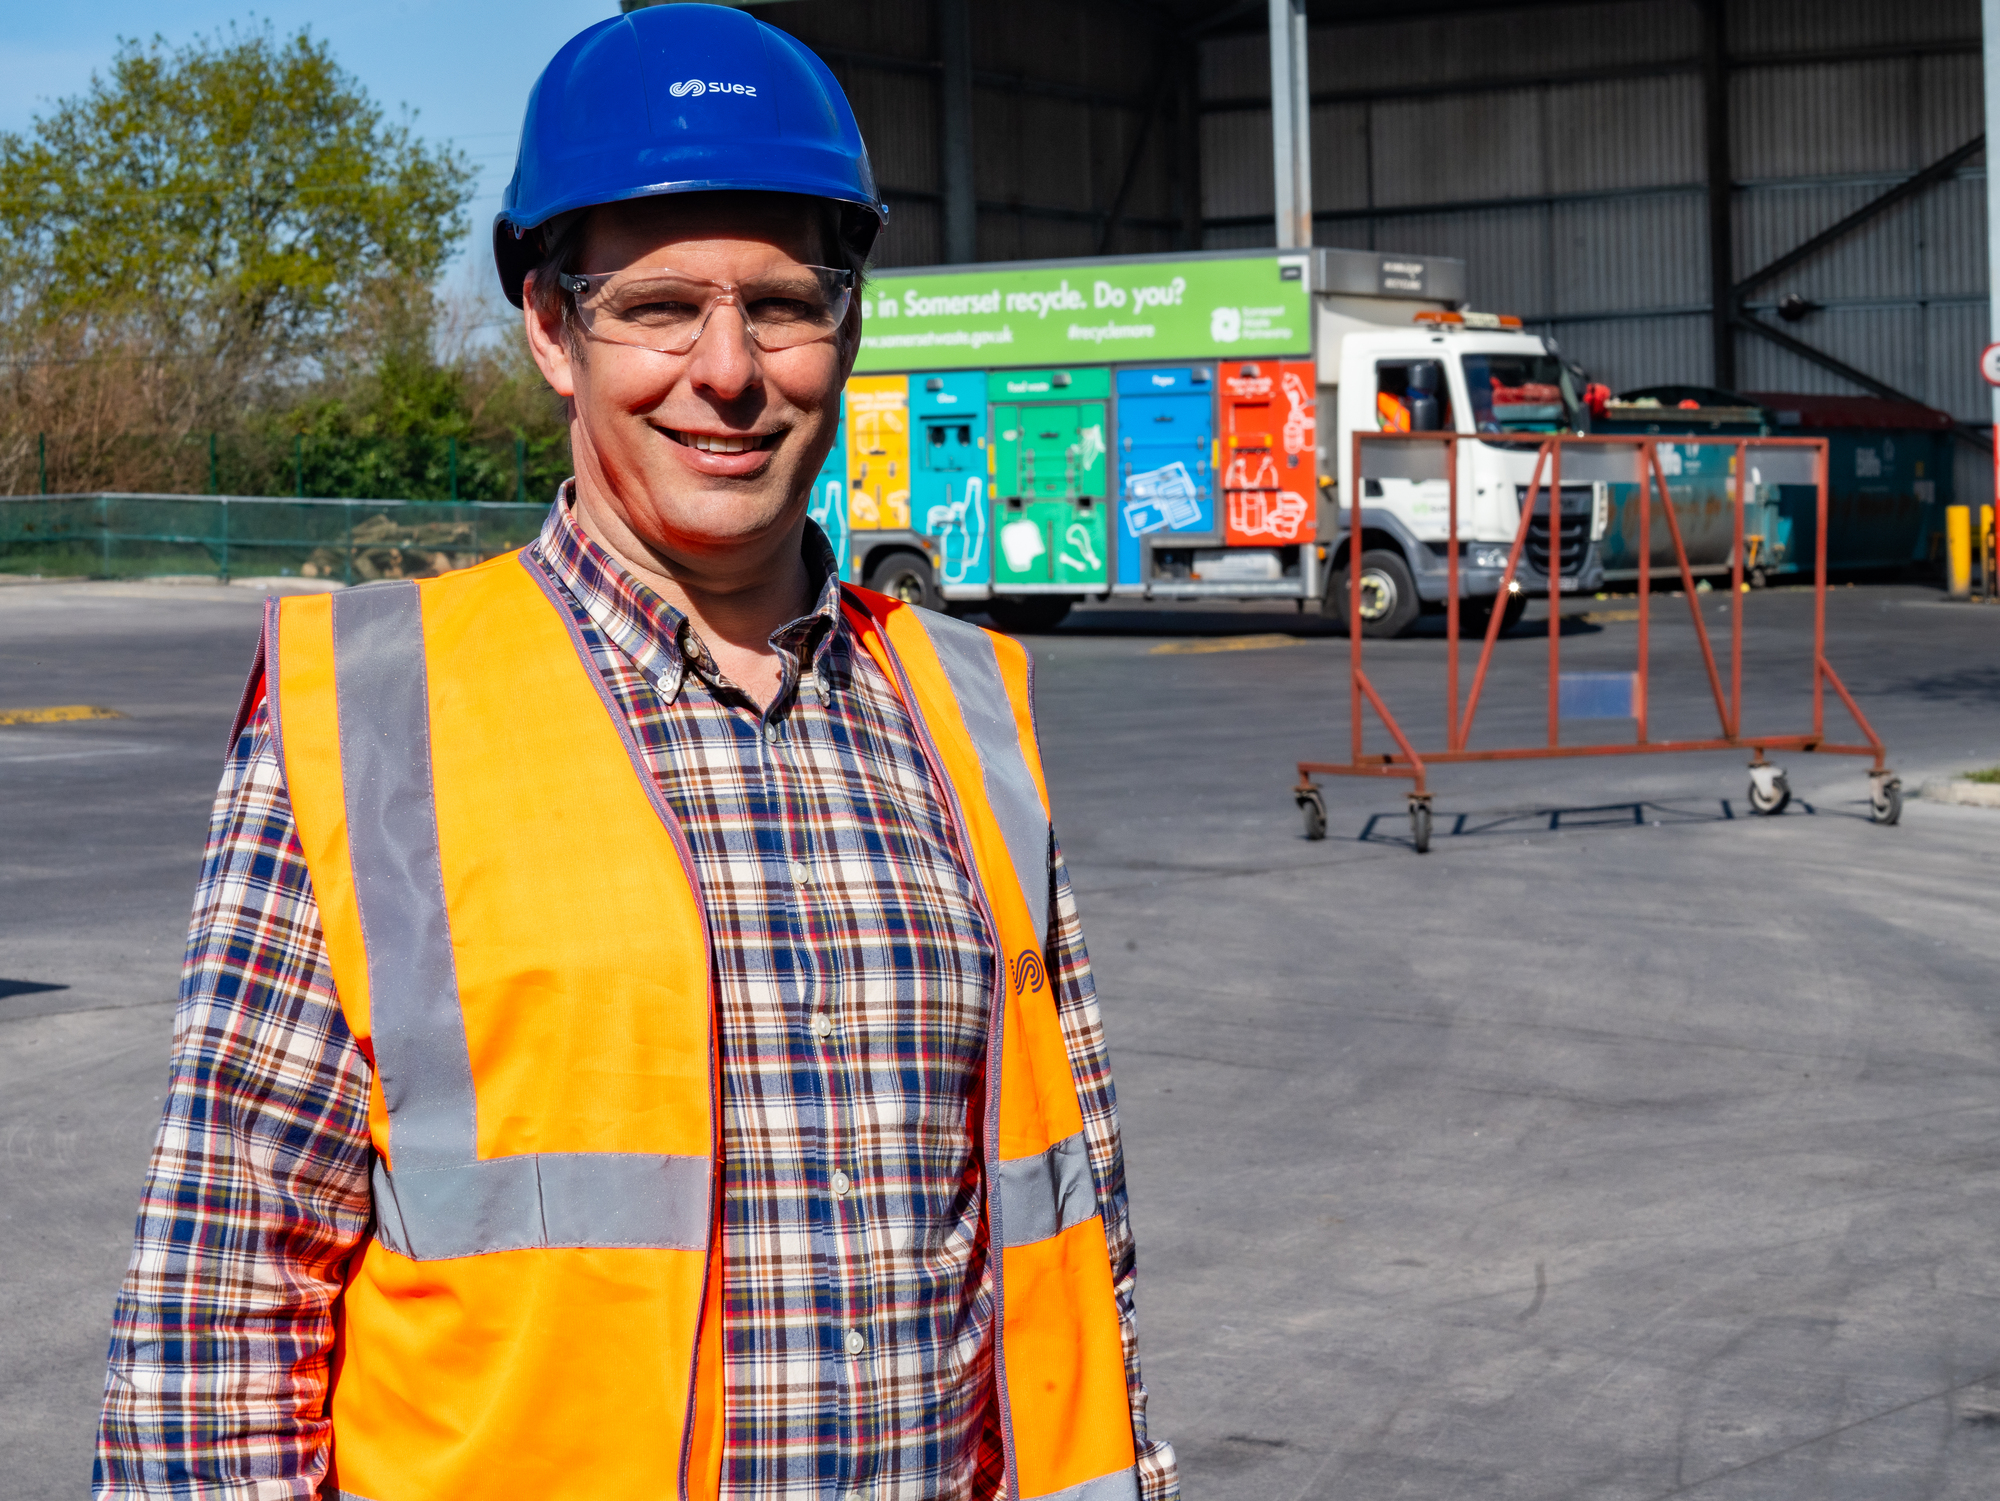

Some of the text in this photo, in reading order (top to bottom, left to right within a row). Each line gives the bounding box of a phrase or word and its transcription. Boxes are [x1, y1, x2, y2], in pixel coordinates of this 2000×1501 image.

[878, 291, 898, 319] in
[904, 288, 1001, 318] Somerset
[1006, 280, 1087, 320] recycle.
[1093, 280, 1127, 309] Do
[1132, 276, 1187, 315] you?
[1067, 320, 1156, 344] #recyclemore
